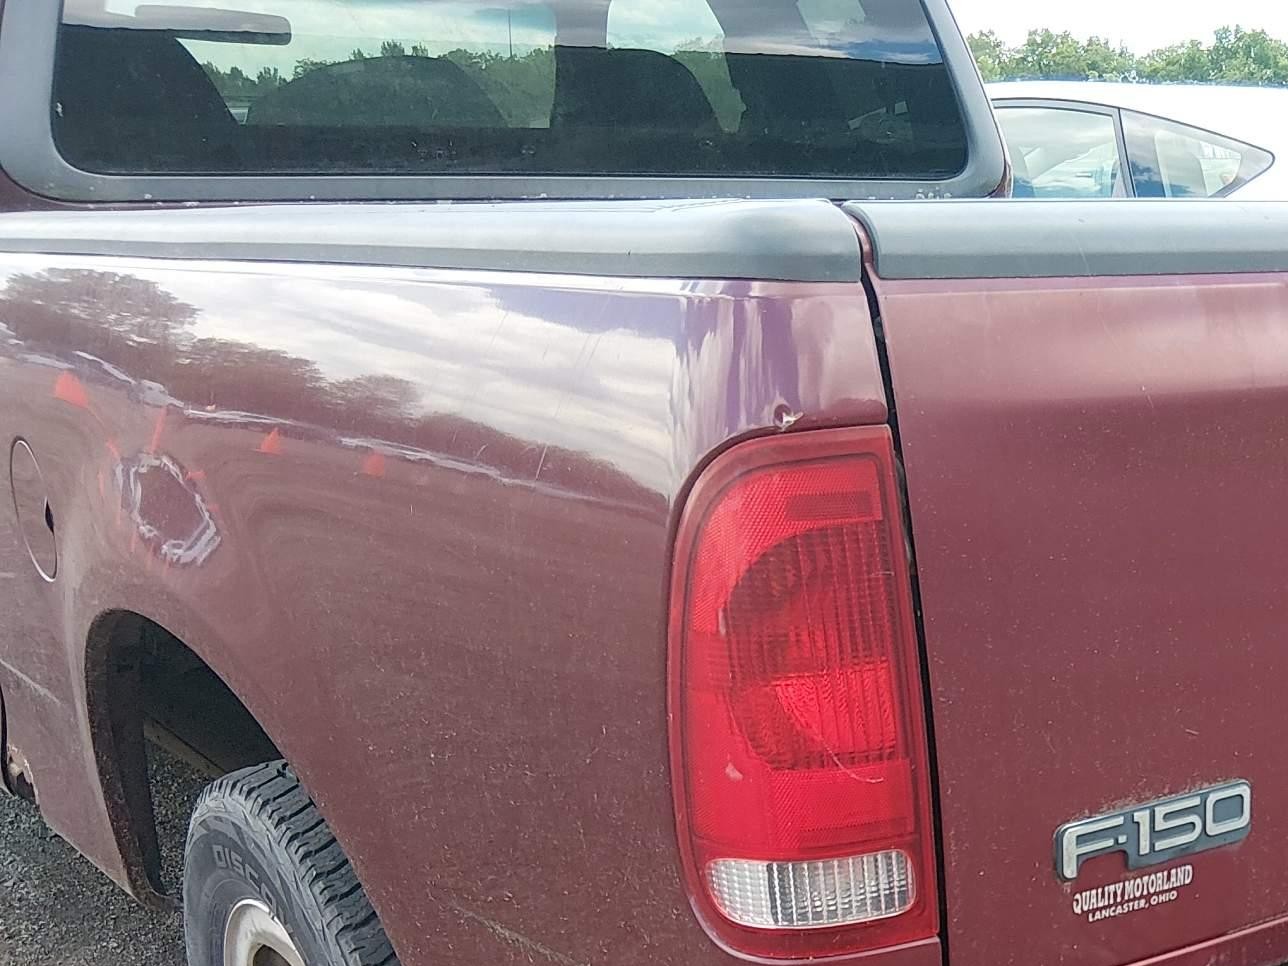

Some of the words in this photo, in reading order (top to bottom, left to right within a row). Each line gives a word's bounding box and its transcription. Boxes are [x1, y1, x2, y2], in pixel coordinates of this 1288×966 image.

[1062, 784, 1251, 879] F-150
[1072, 882, 1124, 915] QUALITY
[1124, 864, 1193, 901] MOTORLAND
[1088, 899, 1149, 922] LANCASTER,
[1150, 890, 1178, 906] OHIO
